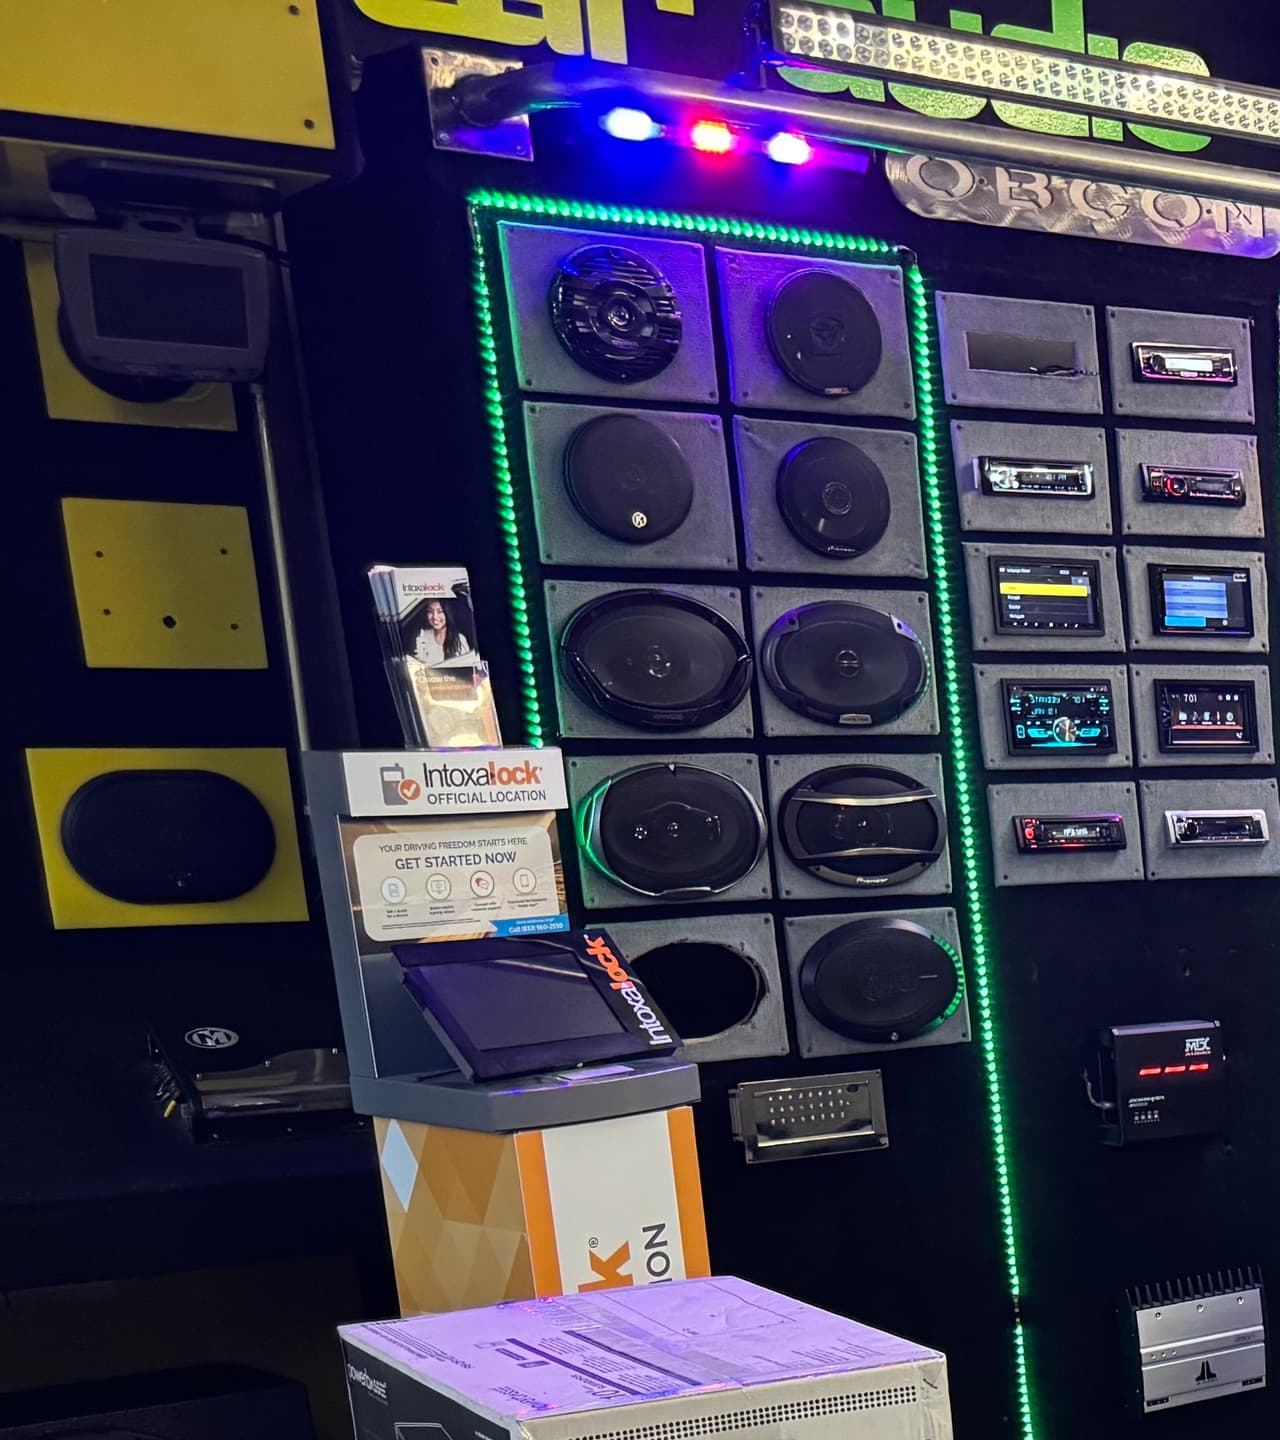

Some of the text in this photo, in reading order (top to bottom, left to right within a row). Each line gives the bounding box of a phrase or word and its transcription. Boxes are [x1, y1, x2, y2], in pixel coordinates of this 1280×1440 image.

[422, 760, 543, 789] Intoxalock
[427, 789, 547, 806] OFFICIAL LOCATION
[379, 836, 528, 853] YOUR DRIVING FREEDOM STARTS HERE
[395, 851, 517, 871] GET STARTED NOW
[583, 934, 673, 1046] Intoxalock
